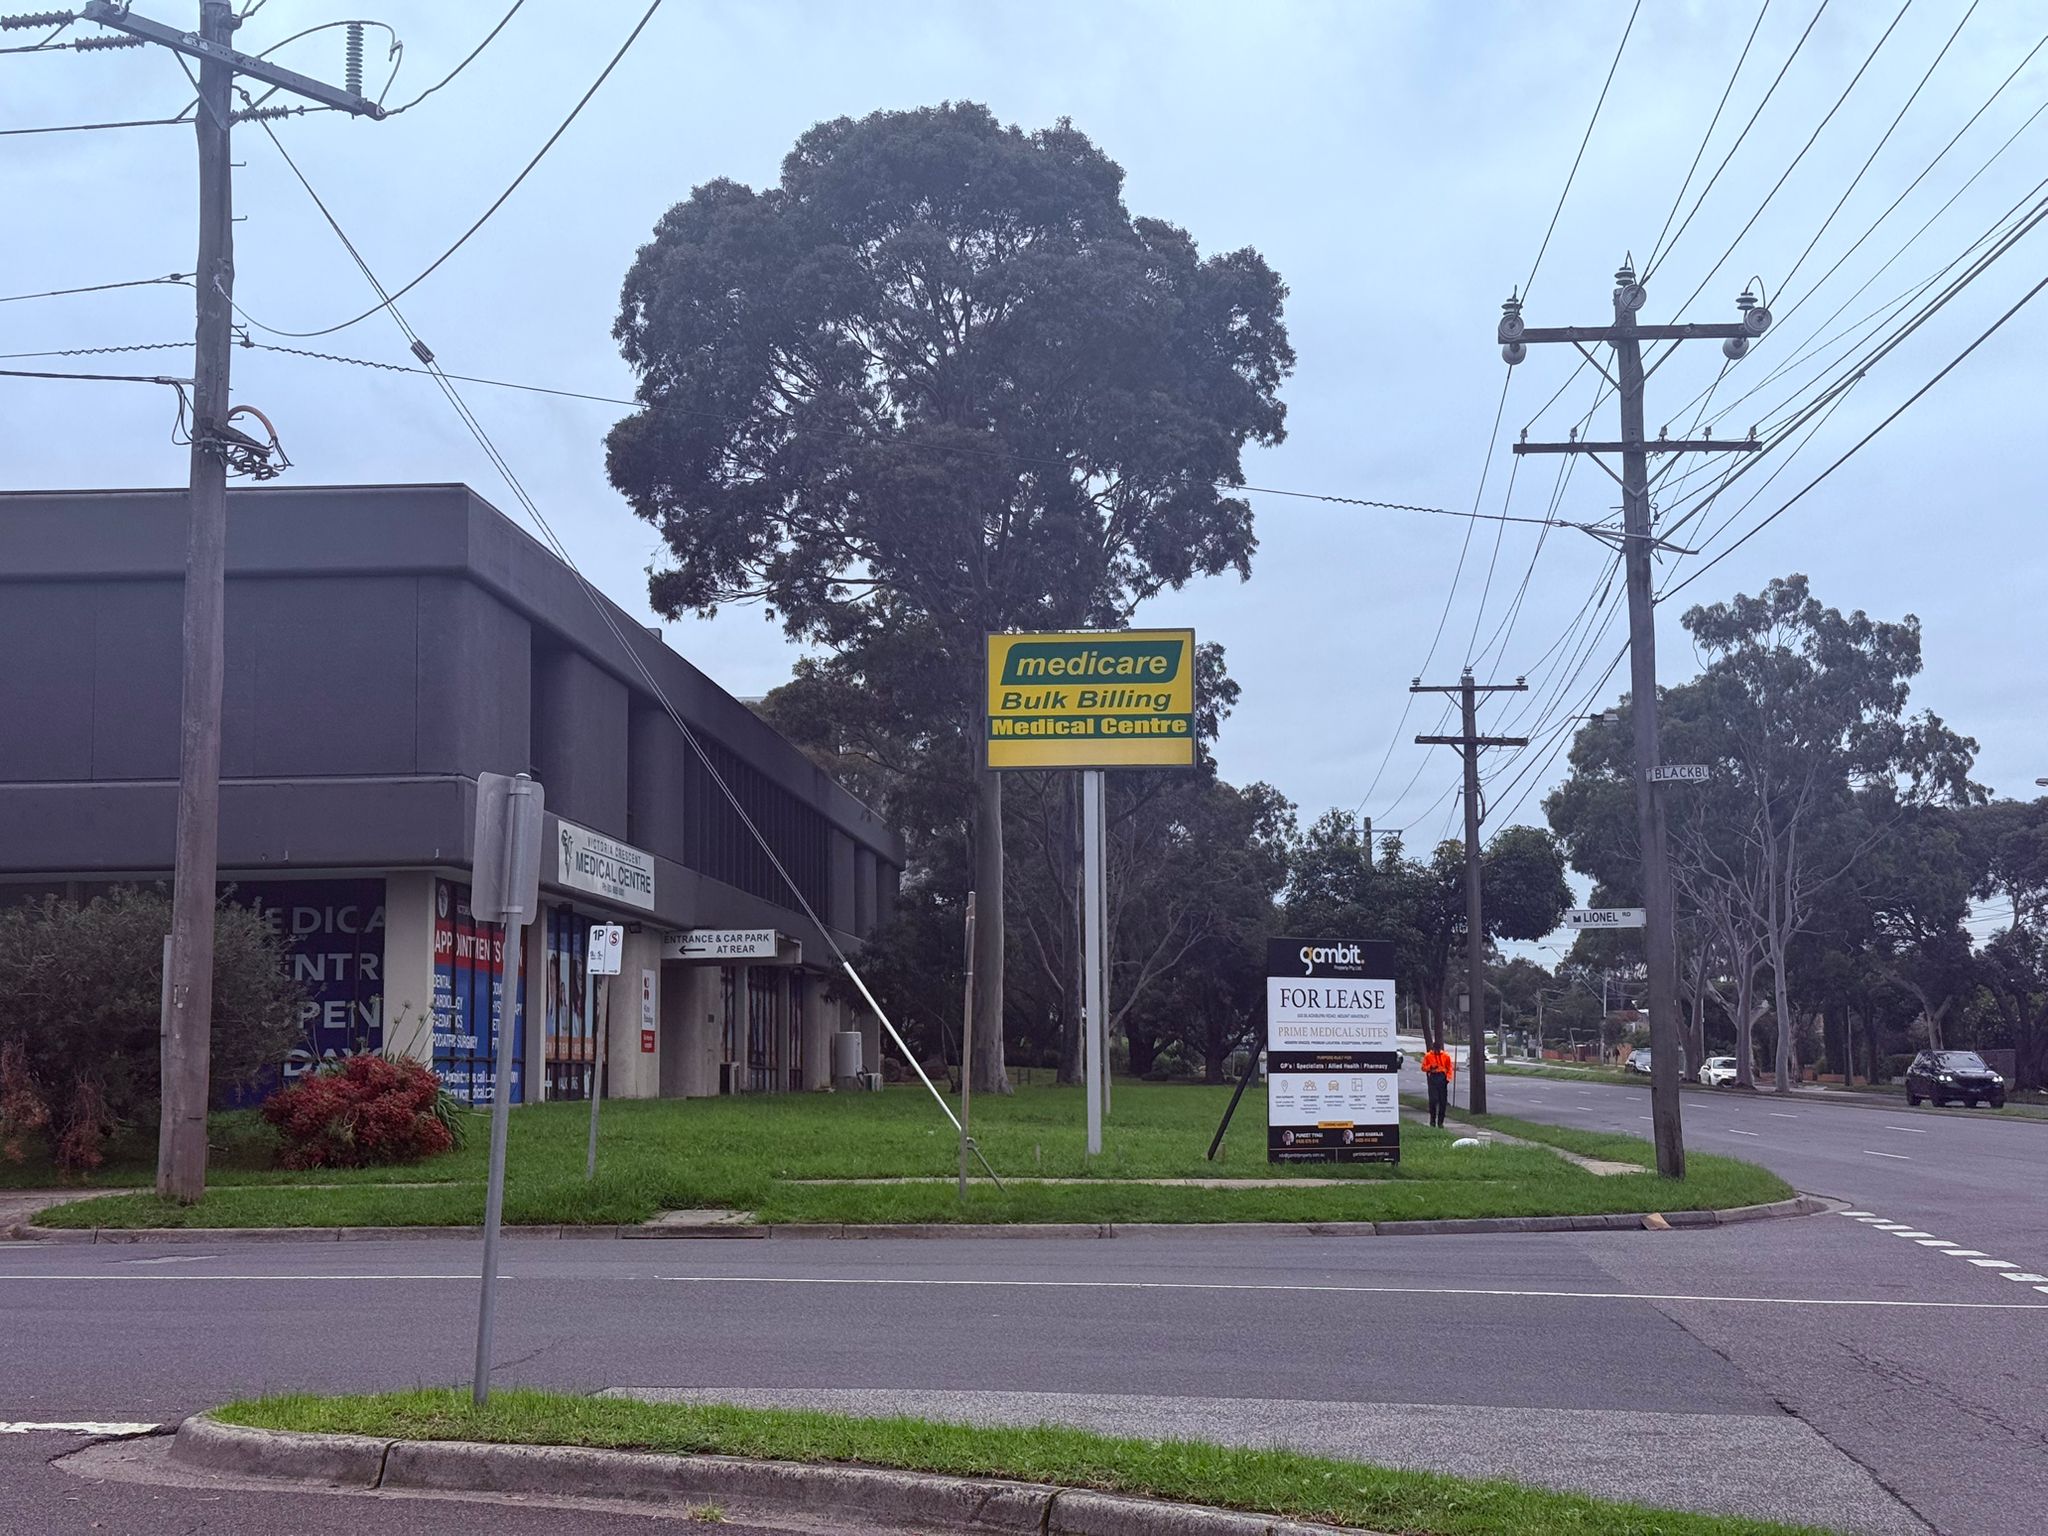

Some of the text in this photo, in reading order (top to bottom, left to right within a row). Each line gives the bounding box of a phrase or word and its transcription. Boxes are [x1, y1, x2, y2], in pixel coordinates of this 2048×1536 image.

[1016, 651, 1168, 676] medicare
[1001, 690, 1171, 711] Bulk Billing
[992, 717, 1187, 736] Medical Centre
[588, 837, 641, 865] VICTORIA CRESCENT
[576, 851, 616, 883] MEDICAL
[618, 866, 651, 894] CENTRE
[271, 906, 385, 934] EDICA
[1584, 912, 1618, 922] LIONEL
[593, 929, 604, 941] 1P
[664, 933, 769, 944] ENTRANCE & CAR PARK
[730, 945, 755, 953] REAR
[1280, 988, 1385, 1009] FOR LEASE
[1278, 1026, 1388, 1037] PRIME MEDICAL SUITES
